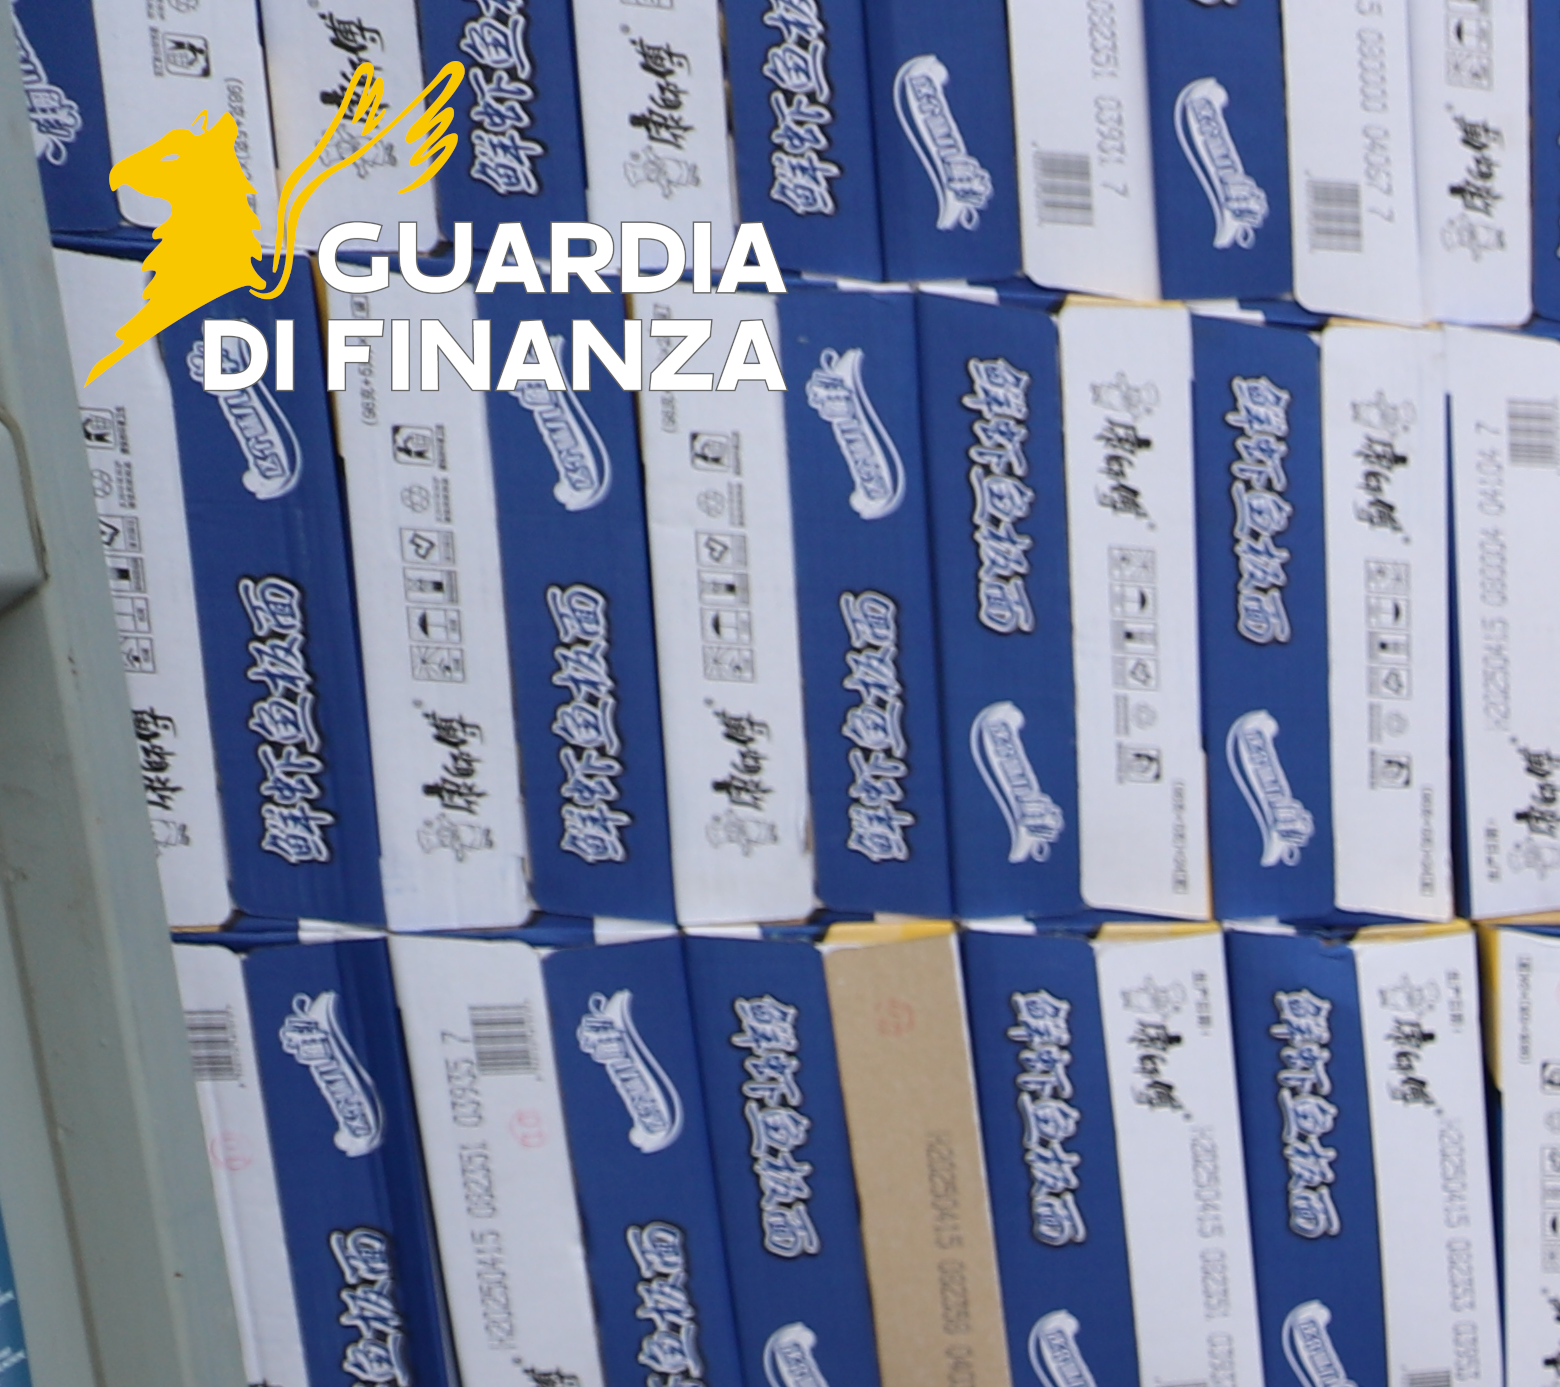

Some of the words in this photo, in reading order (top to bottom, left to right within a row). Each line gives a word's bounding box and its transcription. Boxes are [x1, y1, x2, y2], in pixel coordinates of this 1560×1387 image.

[962, 359, 1034, 632] 鲜虾鱼板面
[1226, 377, 1292, 642] 鲜虾鱼板面
[246, 575, 333, 863] 鲜虾鱼板面
[547, 586, 630, 862] 鲜虾鱼板面
[840, 592, 913, 861] 鲜虾鱼板面
[442, 1030, 469, 1046] 7
[732, 996, 818, 1256] 鲜虾鱼板面
[1008, 991, 1085, 1245] 鲜虾鱼板面
[1271, 990, 1339, 1237] 鲜虾鱼板面
